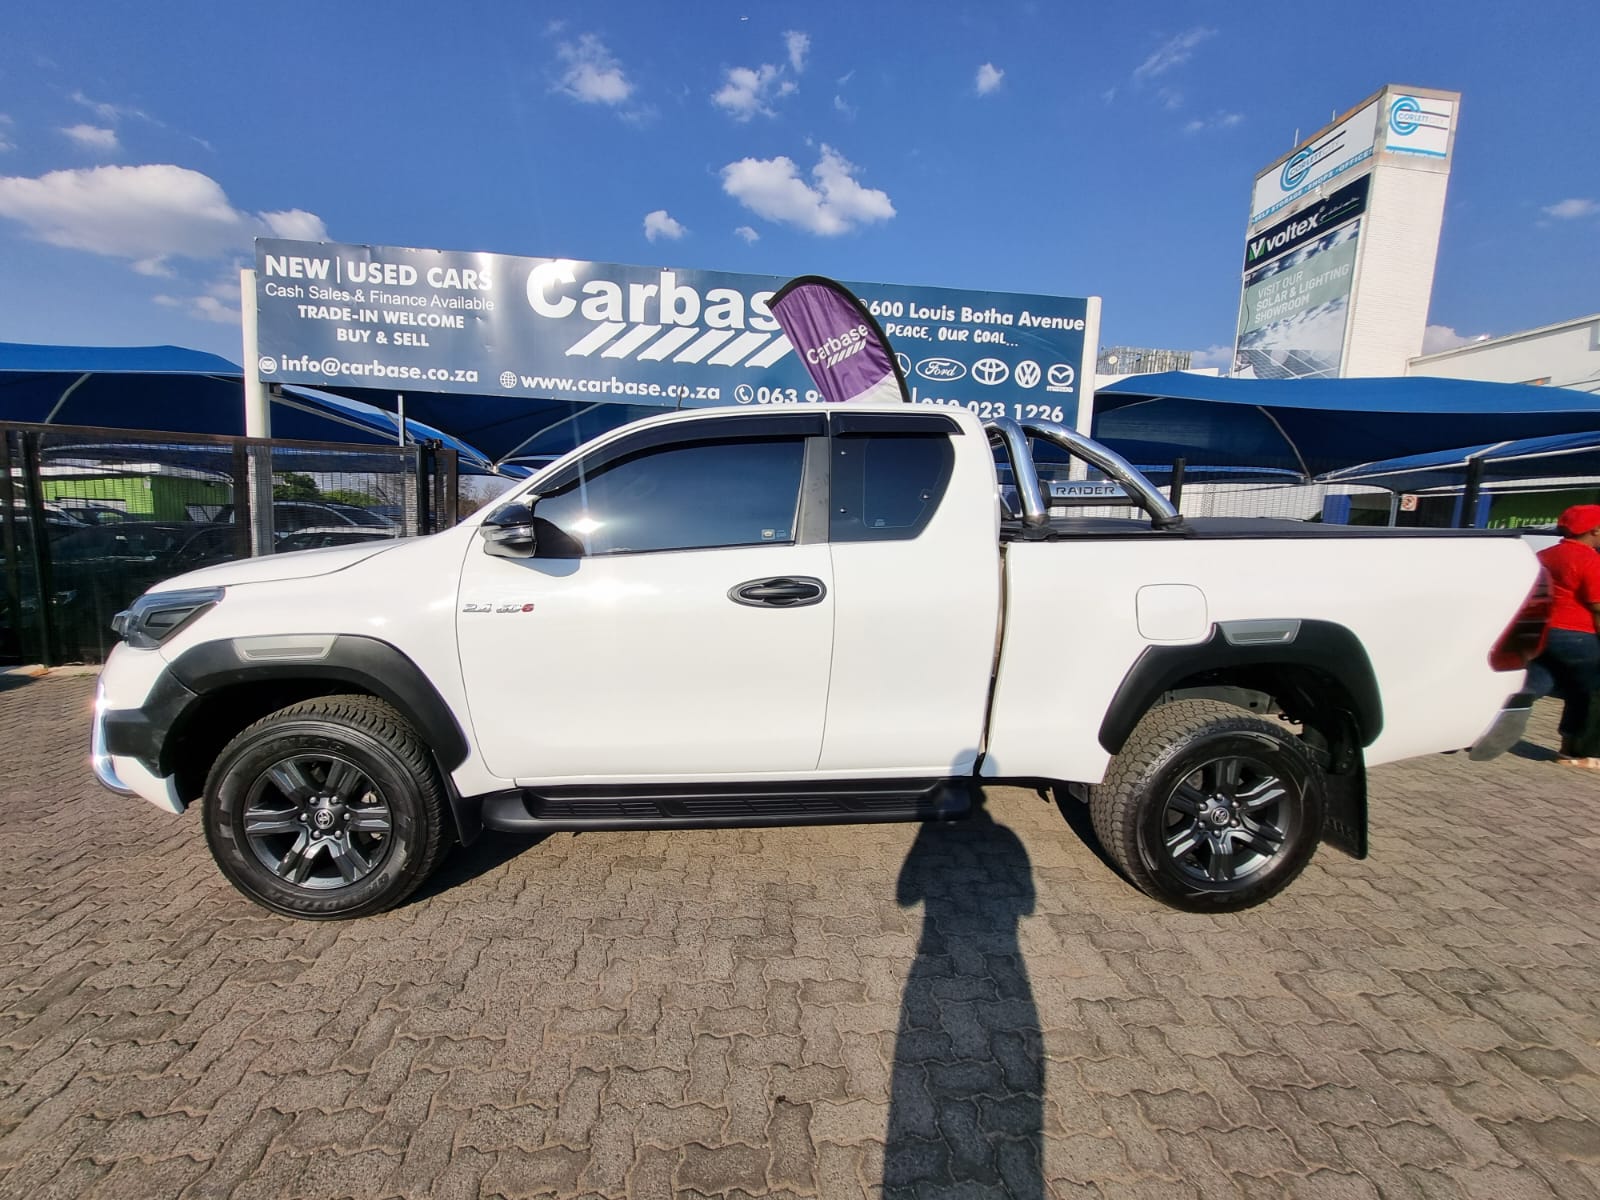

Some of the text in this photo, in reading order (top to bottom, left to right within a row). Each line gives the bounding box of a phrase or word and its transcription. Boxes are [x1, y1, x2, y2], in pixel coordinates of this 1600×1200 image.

[1267, 213, 1320, 251] voltex
[265, 254, 493, 291] NEW USED CARS
[1258, 271, 1304, 299] VISIT OUR
[265, 282, 495, 312] Cash Sales & Finance Available
[526, 262, 784, 331] Carbas
[1256, 290, 1288, 312] SOLAR
[1299, 264, 1349, 294] LIGHTING
[298, 305, 465, 329] TRADE-IN WELCOME
[870, 301, 1085, 331] 600 Louis Botha Avenue
[1254, 294, 1310, 324] SHOWROOM
[337, 328, 430, 347] BUY & SELL
[806, 324, 869, 365] Carbase
[281, 354, 478, 383] info@carbase.co.za
[925, 361, 957, 376] Ford
[520, 374, 721, 400] www.carbase.co.za
[757, 386, 798, 404] 063
[967, 401, 1063, 423] 023 1226
[1056, 486, 1115, 495] RAIDER
